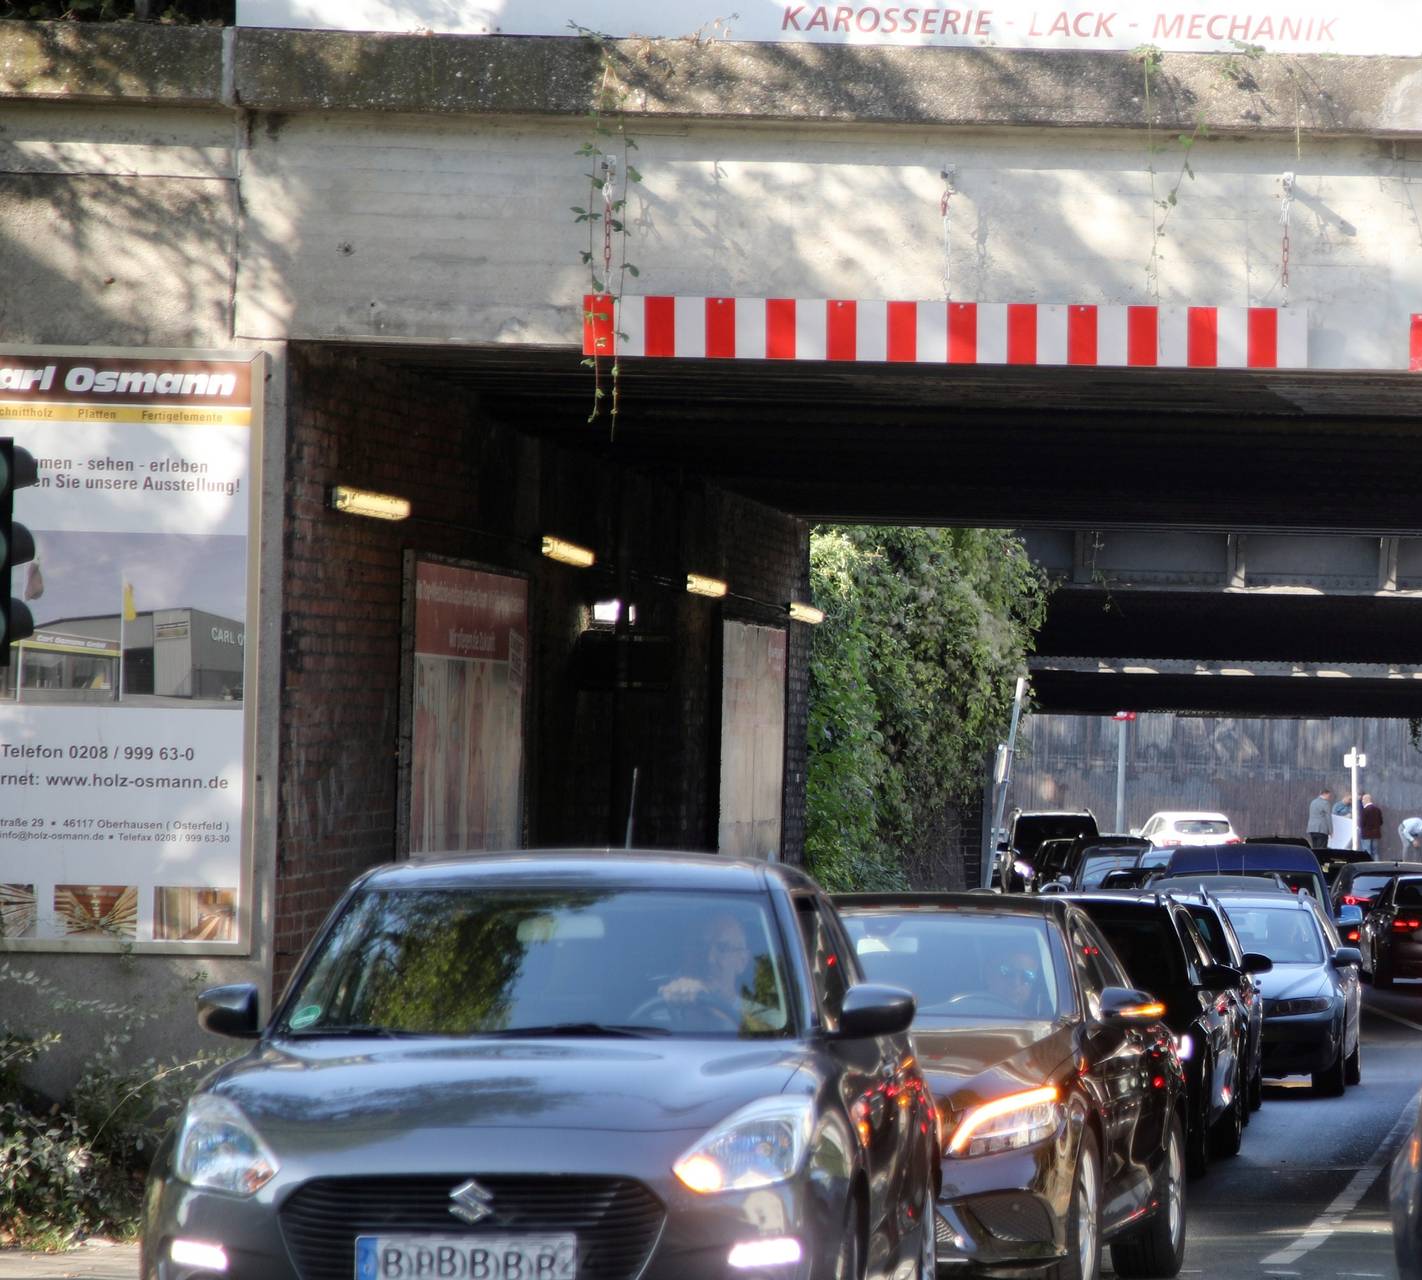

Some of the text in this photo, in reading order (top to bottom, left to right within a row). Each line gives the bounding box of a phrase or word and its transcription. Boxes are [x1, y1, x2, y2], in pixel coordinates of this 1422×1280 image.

[781, 6, 992, 36] KAROSSERIE
[1028, 11, 1116, 38] LACK
[1151, 13, 1339, 42] MECHANIK
[65, 367, 236, 396] Osmann
[141, 410, 224, 423] Fertigelemente
[87, 457, 134, 471] sehen
[150, 458, 208, 473] erleben
[56, 474, 80, 489] Sie
[85, 476, 138, 490] unsere
[143, 475, 241, 496] Ausstellung!
[1, 744, 63, 759] Telefon
[69, 745, 108, 760] 0208
[124, 746, 153, 761] 999
[160, 747, 195, 761] 63-0
[46, 772, 229, 789] www.holz-osmann.de
[32, 818, 44, 828] 29
[63, 818, 94, 829] 46117
[97, 818, 163, 830] Oberhausen
[173, 820, 223, 831] Osterfeld
[118, 832, 151, 842] Telefax
[154, 833, 177, 843] 0208
[185, 834, 202, 843] 999
[204, 834, 230, 844] 63-30
